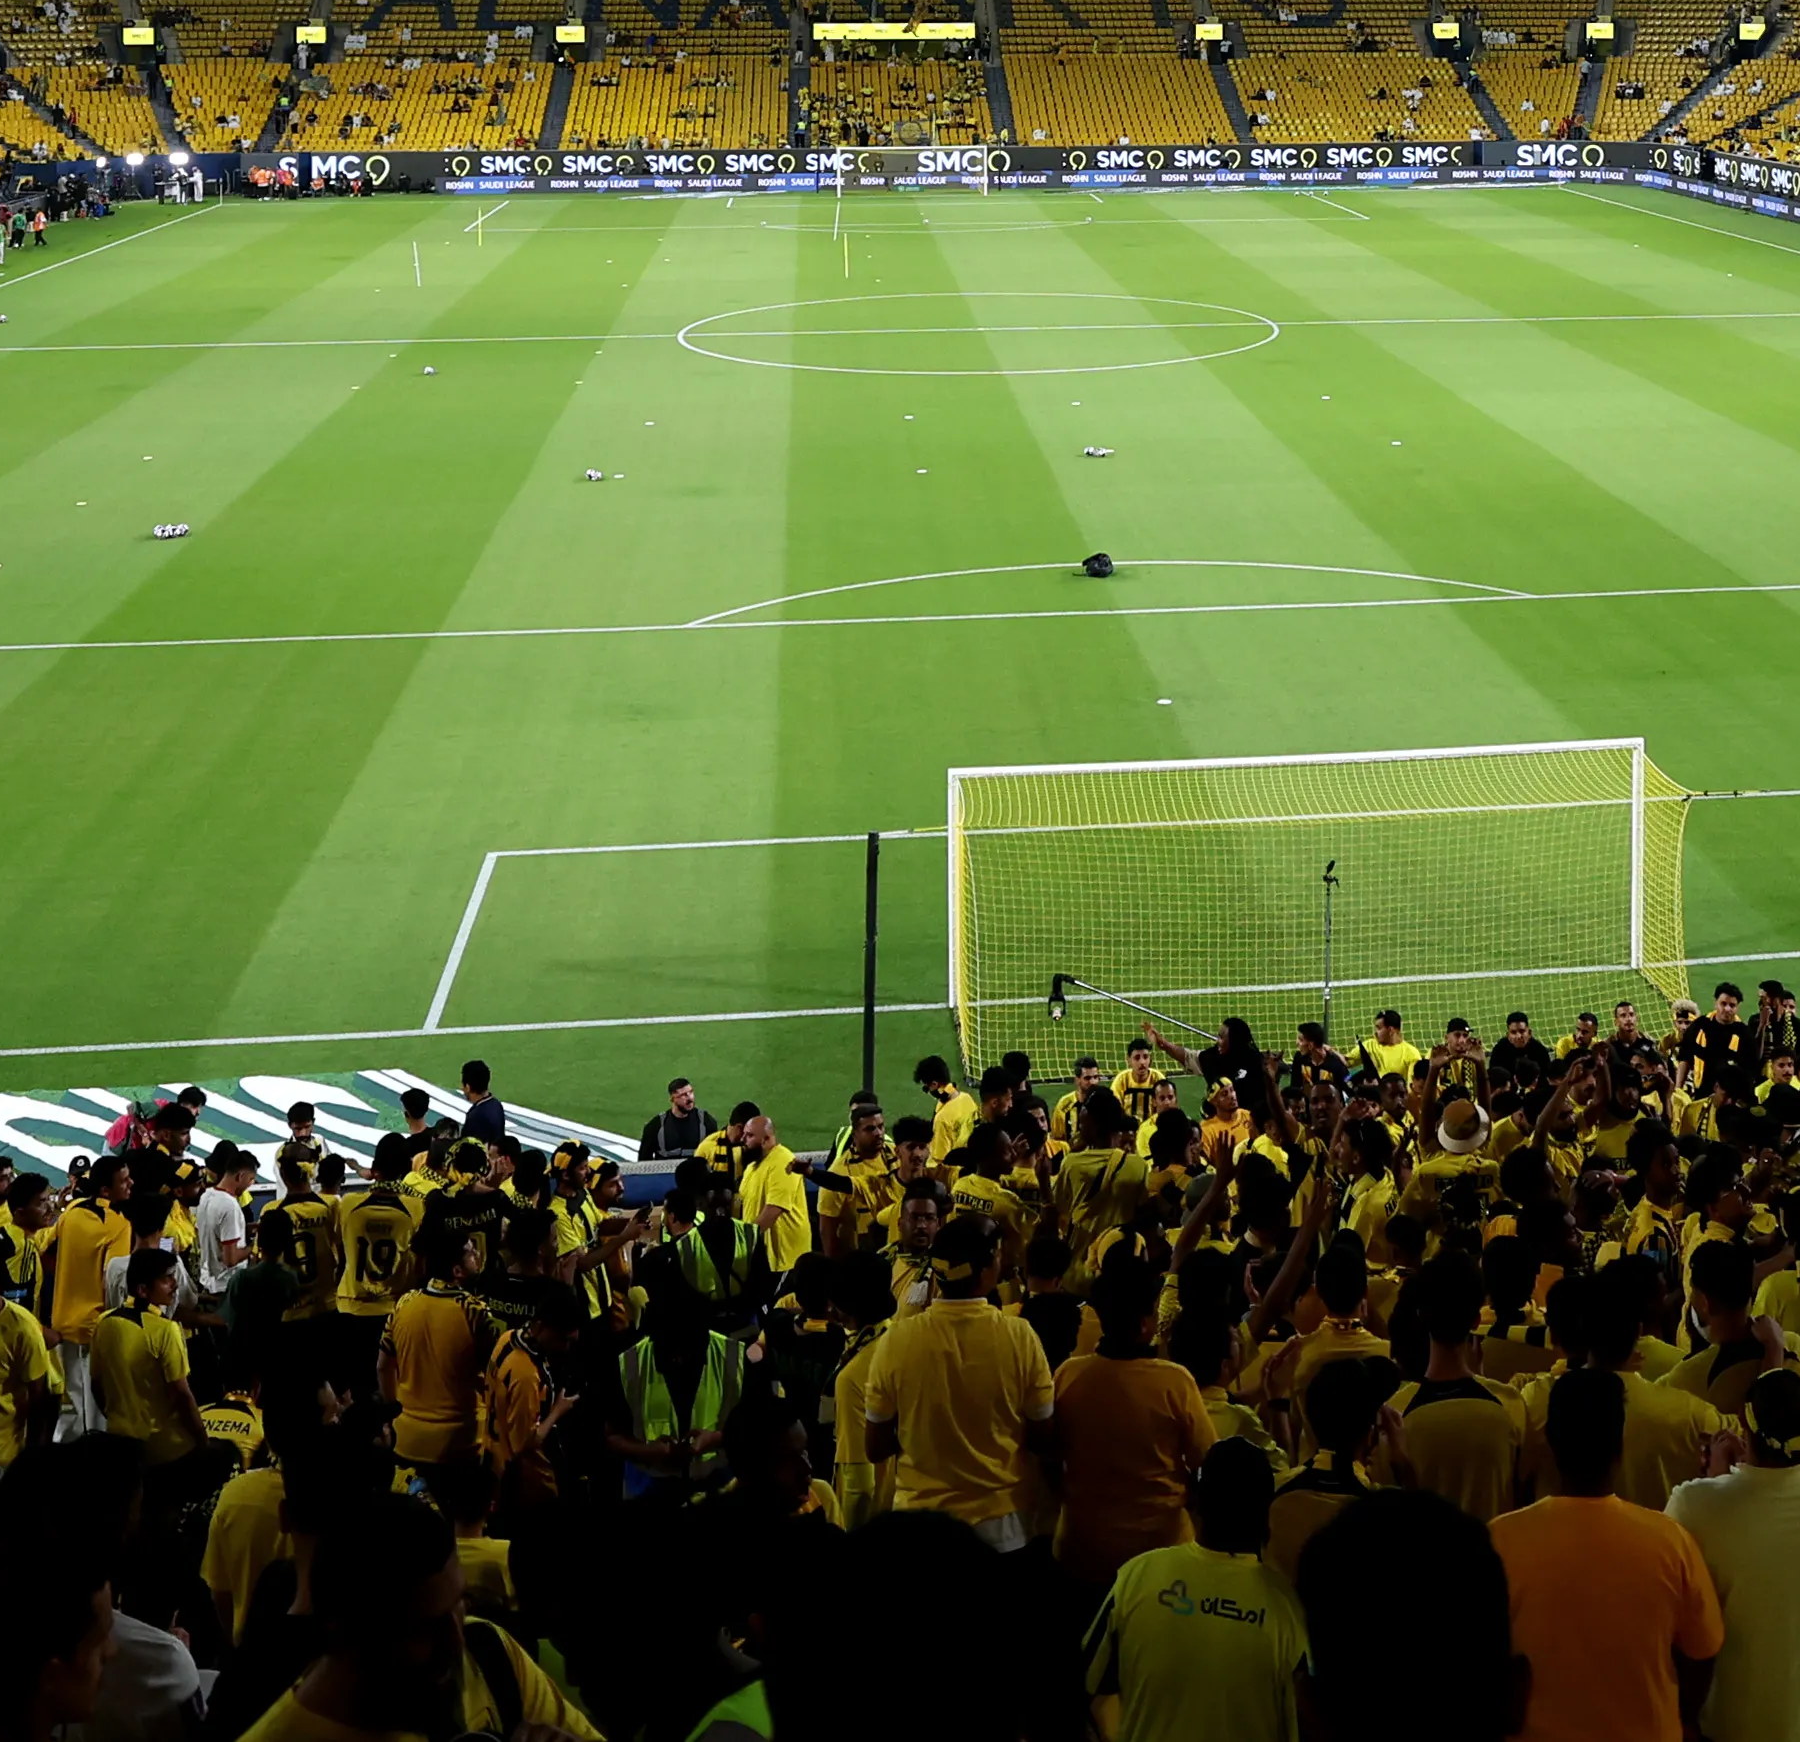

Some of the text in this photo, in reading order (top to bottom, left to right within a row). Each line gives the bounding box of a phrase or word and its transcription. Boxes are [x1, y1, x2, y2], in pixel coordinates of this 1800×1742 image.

[563, 155, 613, 173] SMC
[725, 155, 775, 173] SMC
[917, 150, 983, 173] SMC
[1097, 150, 1144, 168] SMC
[1173, 149, 1221, 168] SMC
[1251, 148, 1297, 166] SMC
[1327, 147, 1373, 165] SMC
[1401, 146, 1449, 164] SMC
[480, 155, 531, 174] SMC
[1740, 162, 1760, 183] SMC
[654, 178, 743, 188] ROSHN SAUDI LEAGUE
[758, 177, 786, 187] ROSHN
[791, 177, 815, 187] SAUDI
[893, 176, 916, 186] SAUDI
[918, 176, 947, 185] LEAGUE
[1061, 174, 1147, 183] ROSHN SAUDI LEAGUE
[1161, 173, 1245, 182] ROSHN SAUDI LEAGUE
[1259, 172, 1342, 182] ROSHN SAUDI LEAGUE
[1357, 171, 1439, 181] ROSHN SAUDI LEAGUE
[1452, 169, 1535, 179] ROSHN SAUDI LEAGUE
[1771, 166, 1792, 189] SMC
[445, 179, 536, 190] ROSHN SAUDI LEAGUE
[551, 179, 640, 189] ROSHN SAUDI LEAGUE
[356, 1235, 397, 1282] 19
